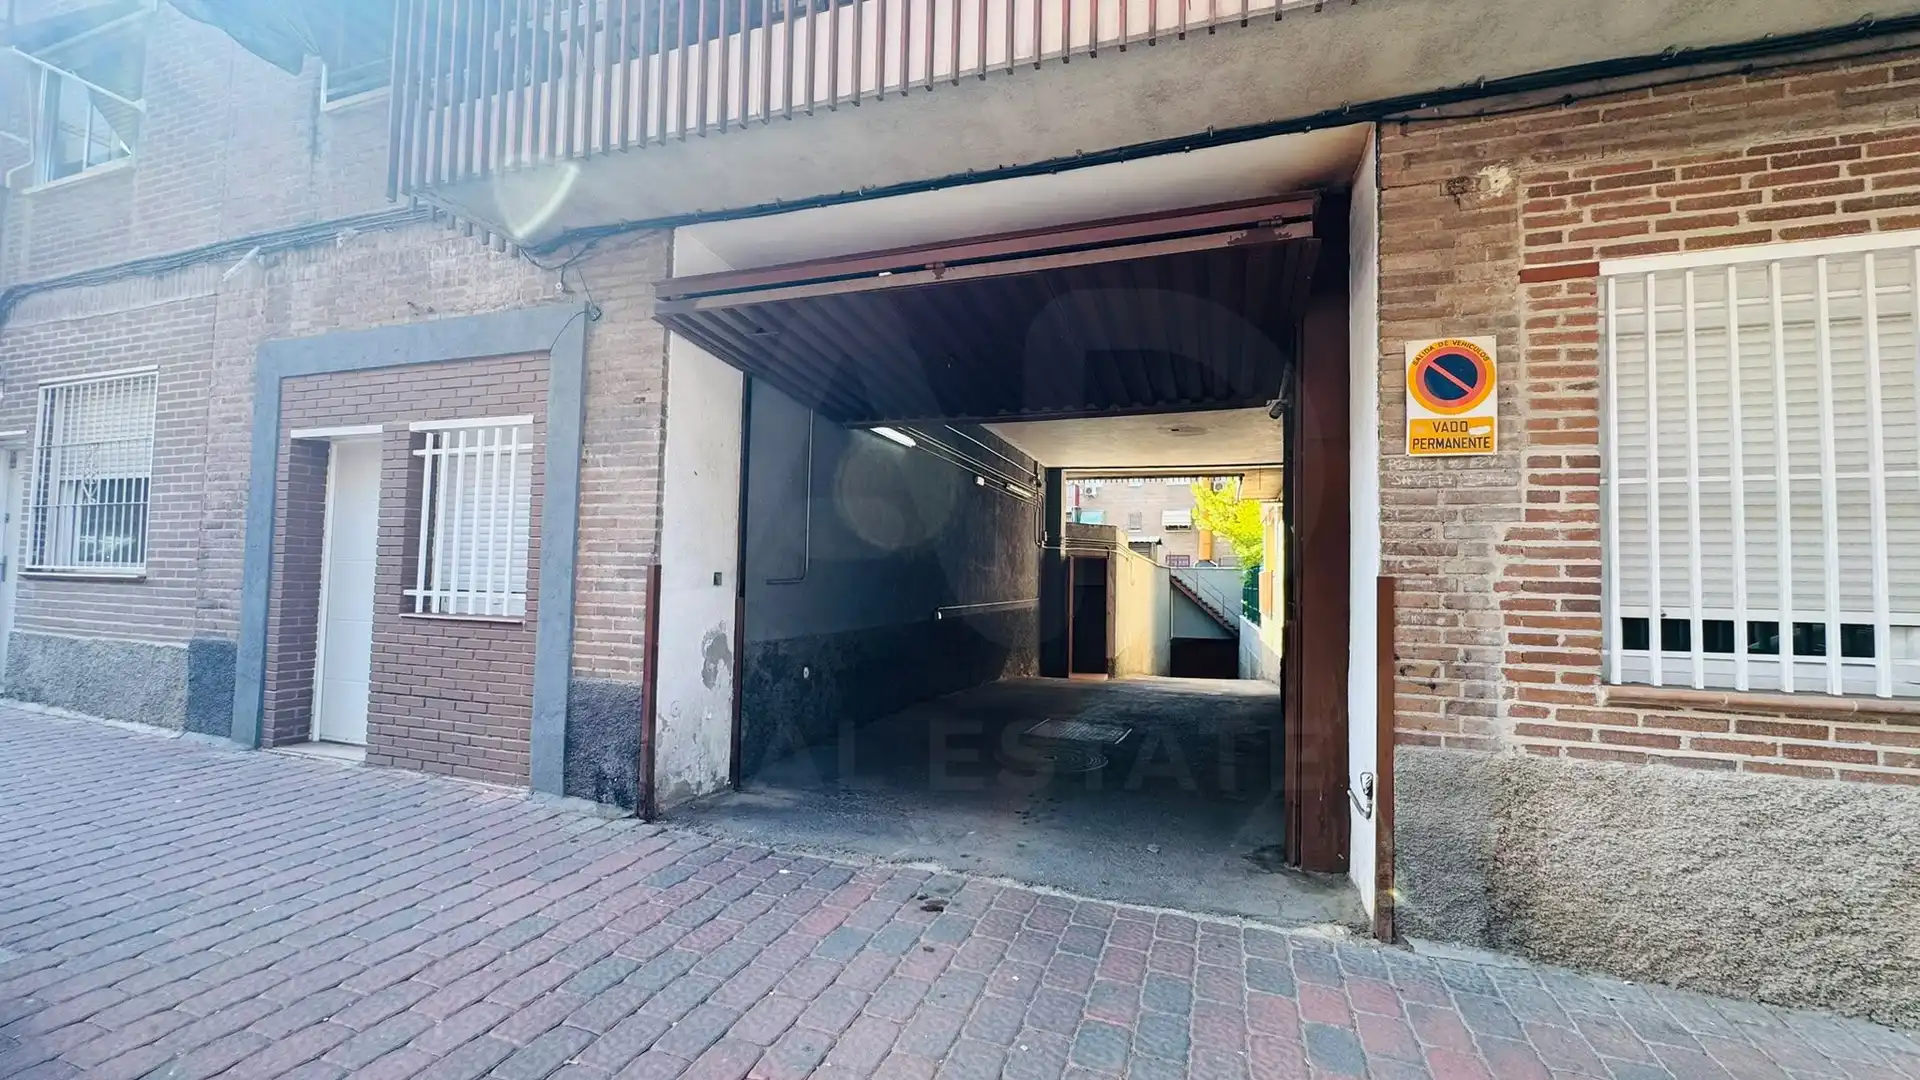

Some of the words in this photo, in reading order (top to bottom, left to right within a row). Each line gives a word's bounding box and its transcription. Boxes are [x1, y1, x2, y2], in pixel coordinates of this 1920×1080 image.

[1411, 344, 1435, 366] SALIDA
[1437, 340, 1449, 348] DE
[1452, 339, 1490, 362] VEHICULOS
[1432, 420, 1469, 433] VADO
[1412, 436, 1491, 450] PERMANENTE
